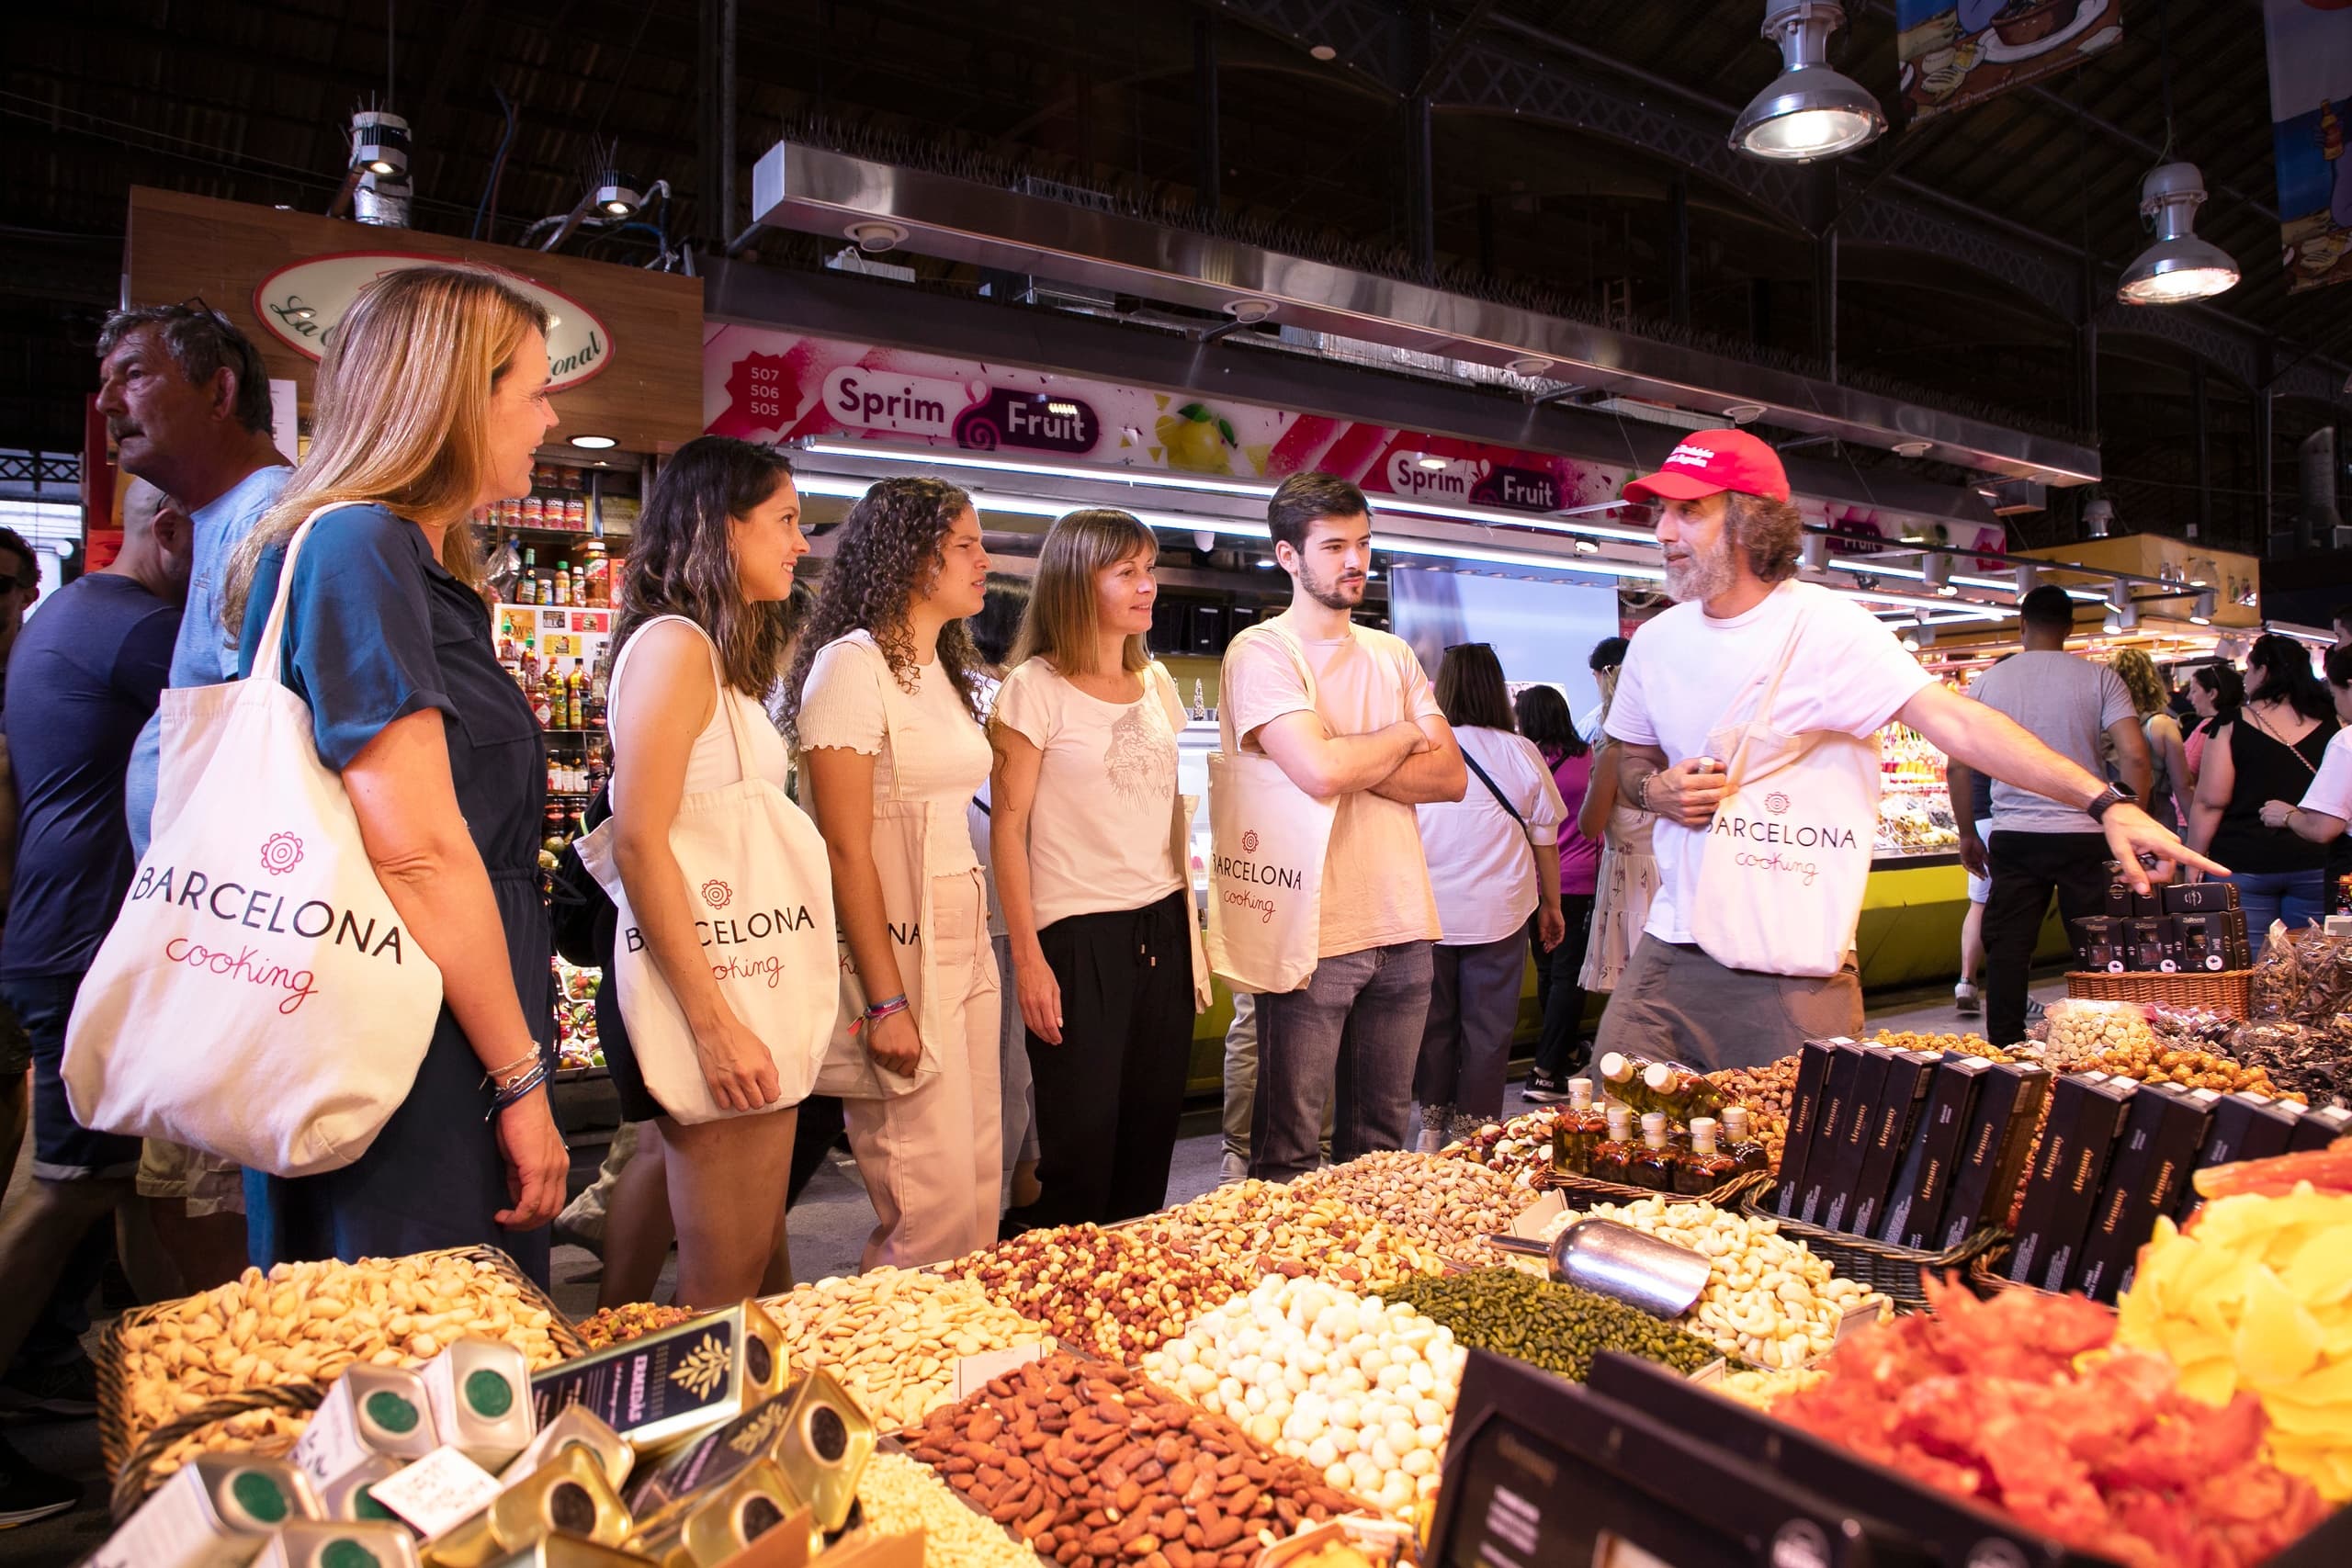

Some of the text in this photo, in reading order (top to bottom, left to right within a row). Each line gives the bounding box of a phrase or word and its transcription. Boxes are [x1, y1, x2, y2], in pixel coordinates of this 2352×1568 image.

[269, 295, 319, 336] La
[548, 331, 601, 377] onal
[750, 367, 780, 382] 507
[750, 384, 780, 400] 506
[750, 401, 780, 417] 505
[838, 377, 1086, 443] Sprim Fruit
[1396, 458, 1554, 507] Sprim Fruit
[1735, 852, 1819, 886] cooking
[131, 865, 402, 964] BARCELONA
[1223, 888, 1276, 924] cooking
[625, 905, 816, 953] BCELONA
[165, 938, 319, 1014] cooking
[711, 954, 786, 989] oking
[1795, 1094, 1811, 1134] Alemany
[1823, 1097, 1840, 1138] Alemany
[1849, 1103, 1869, 1145] Alemany
[1877, 1106, 1897, 1149] Alemany
[1972, 1122, 1994, 1167] Alemany
[2041, 1134, 2064, 1181] Alemany
[1922, 1158, 1940, 1201] Alemany
[2072, 1147, 2094, 1194] Alemany
[2149, 1160, 2175, 1207] Alemany
[2102, 1188, 2128, 1235] Alemany
